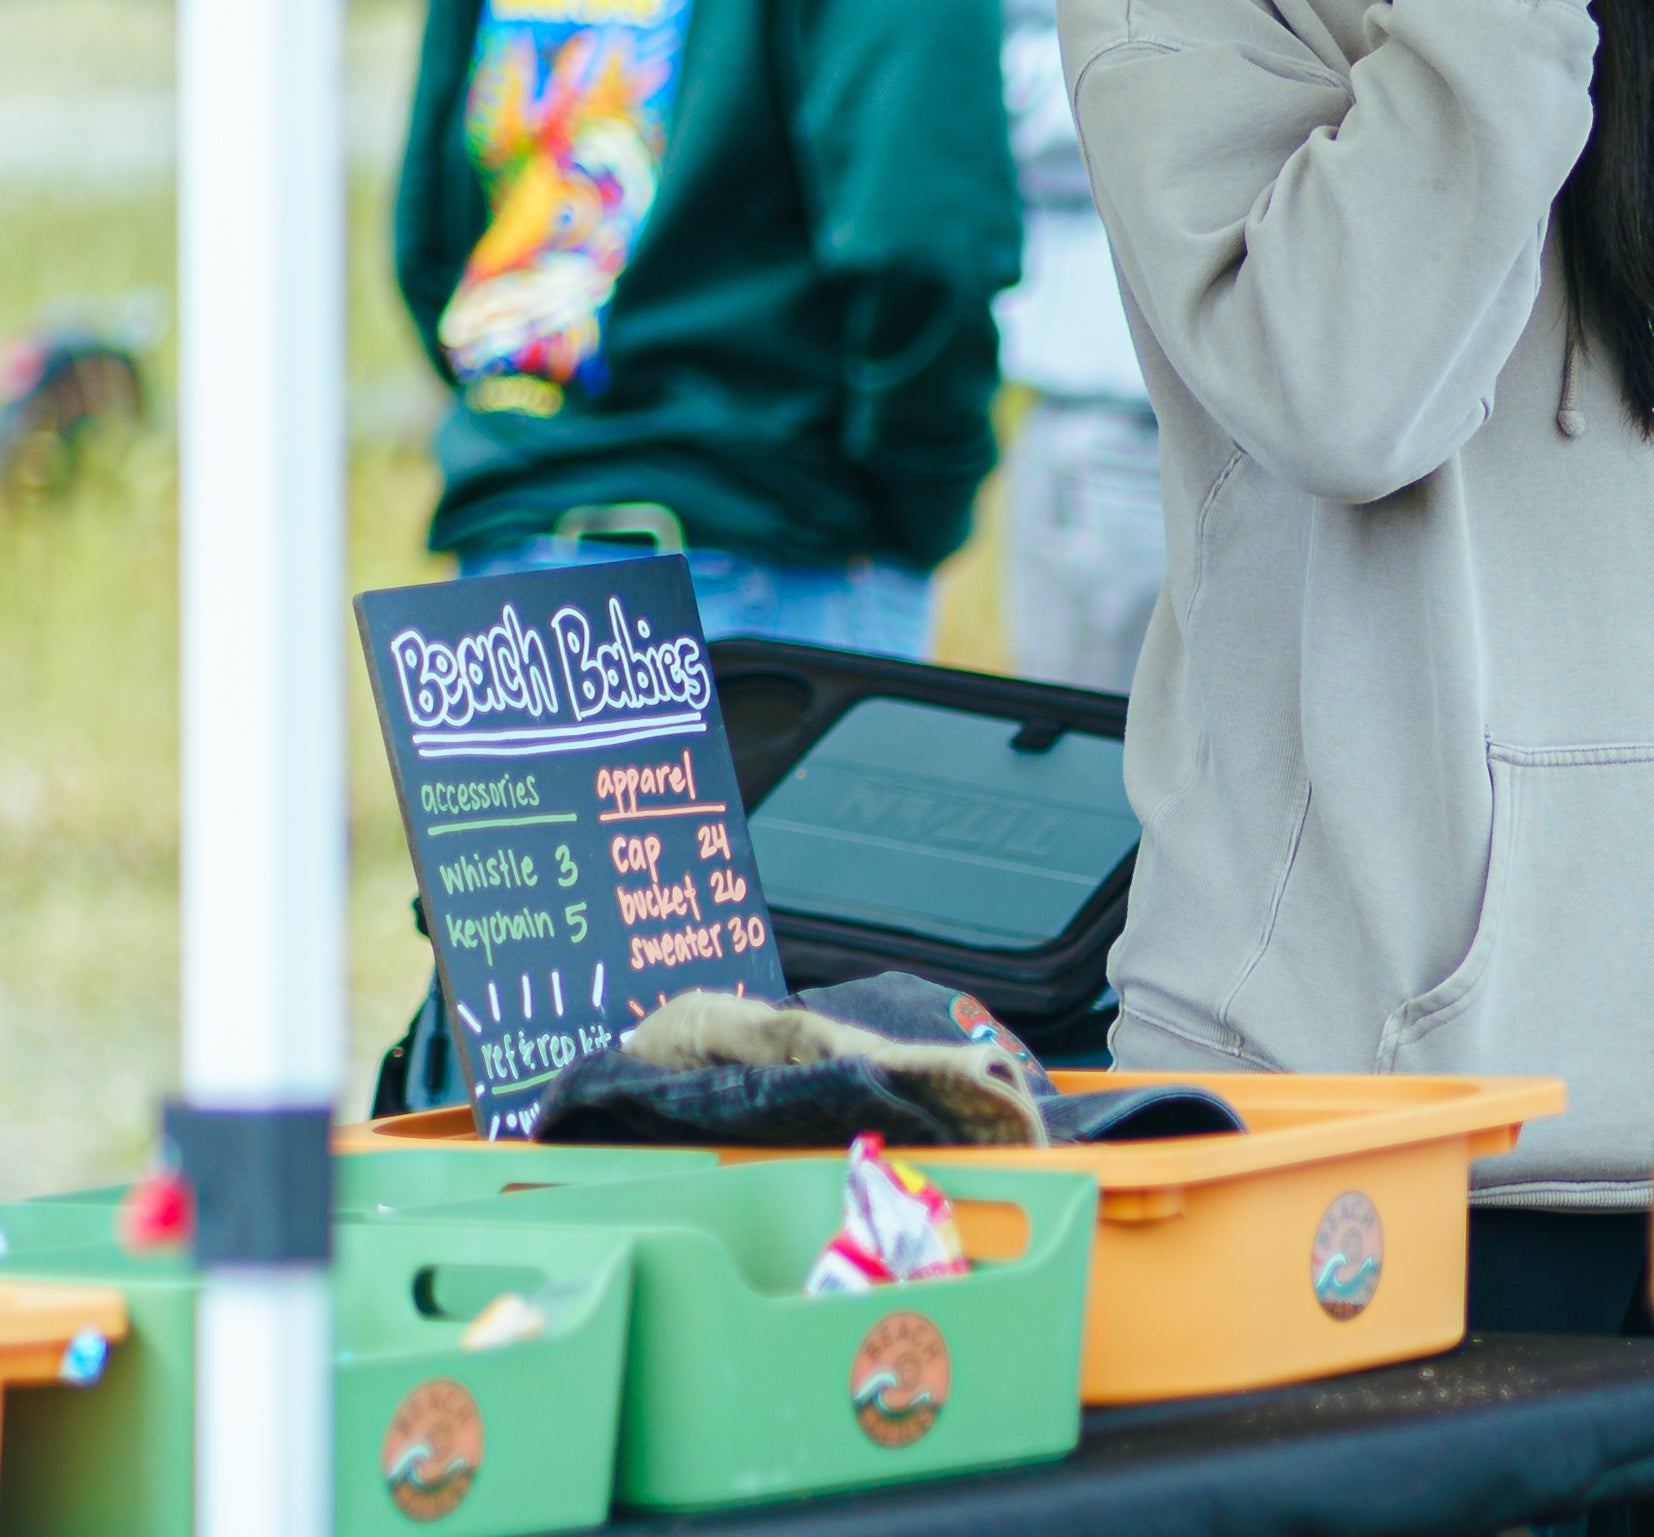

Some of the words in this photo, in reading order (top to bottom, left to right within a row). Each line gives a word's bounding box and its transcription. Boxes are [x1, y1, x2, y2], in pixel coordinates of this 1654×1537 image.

[392, 605, 557, 727] Beach
[552, 597, 711, 720] Babies
[421, 772, 540, 814] accessories
[596, 751, 696, 812] apparel
[439, 848, 538, 894] whistle
[555, 844, 579, 888] 3
[612, 834, 661, 882] cap
[698, 823, 730, 862] 24
[618, 873, 698, 925] bucket
[710, 869, 746, 904] 26
[446, 908, 554, 967] keychain
[566, 902, 588, 943] 5
[631, 920, 723, 971] sweater
[728, 914, 766, 953] 30
[481, 1033, 519, 1080] ref
[578, 1024, 612, 1055] kit
[866, 1321, 942, 1359] BEACH
